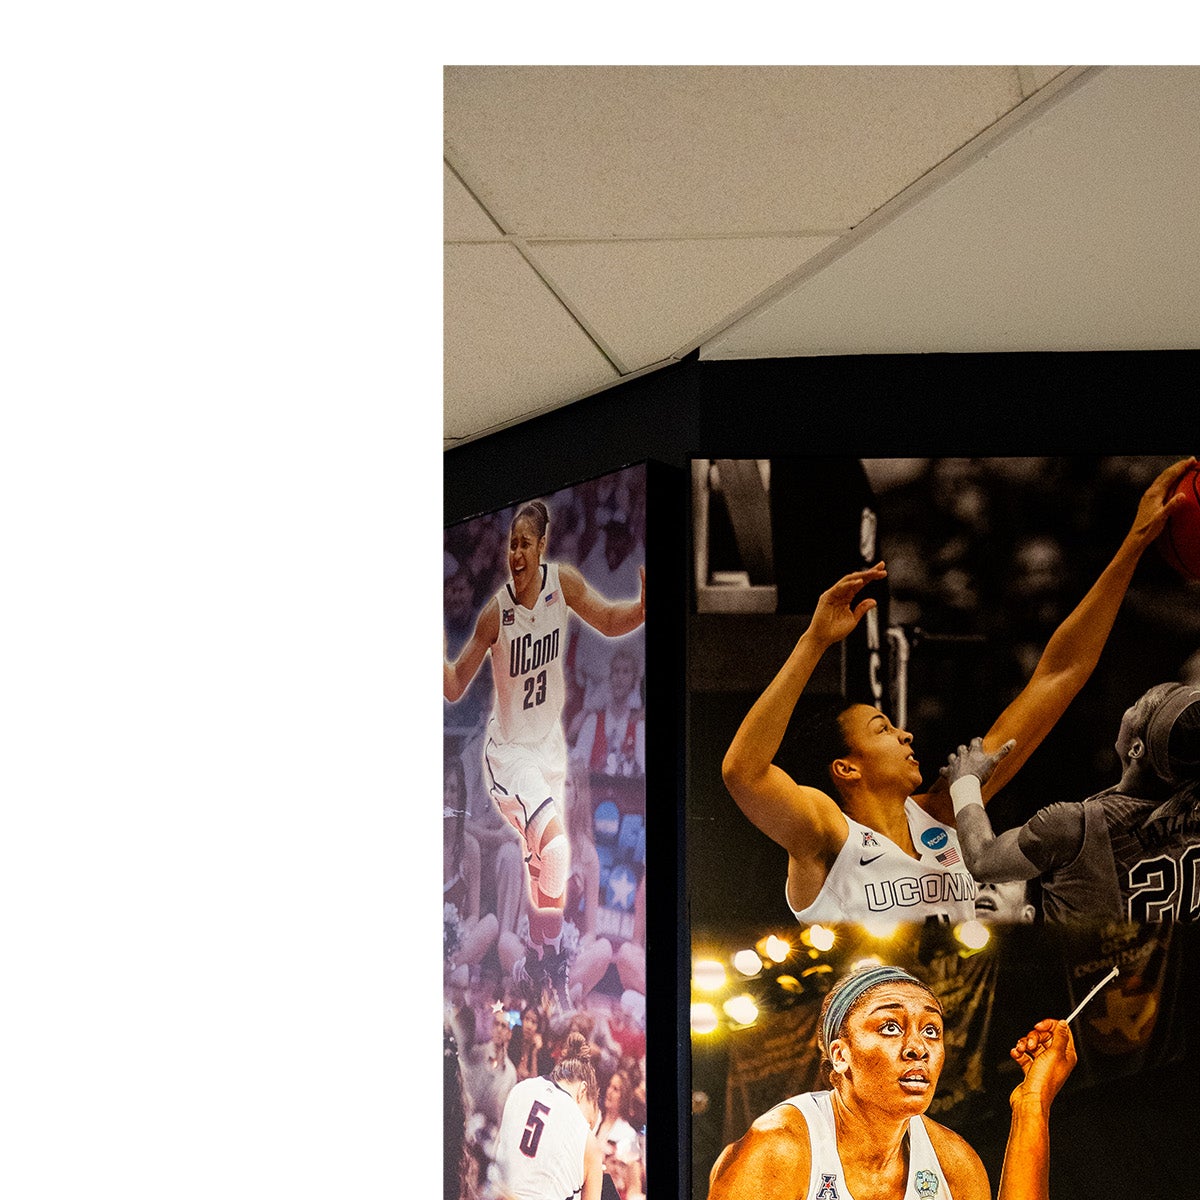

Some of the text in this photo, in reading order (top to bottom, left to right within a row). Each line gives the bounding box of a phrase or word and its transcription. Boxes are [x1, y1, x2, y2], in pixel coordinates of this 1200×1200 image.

[510, 628, 560, 678] UConn
[523, 669, 547, 711] 23
[865, 871, 976, 914] UCONN
[519, 1100, 550, 1158] 5
